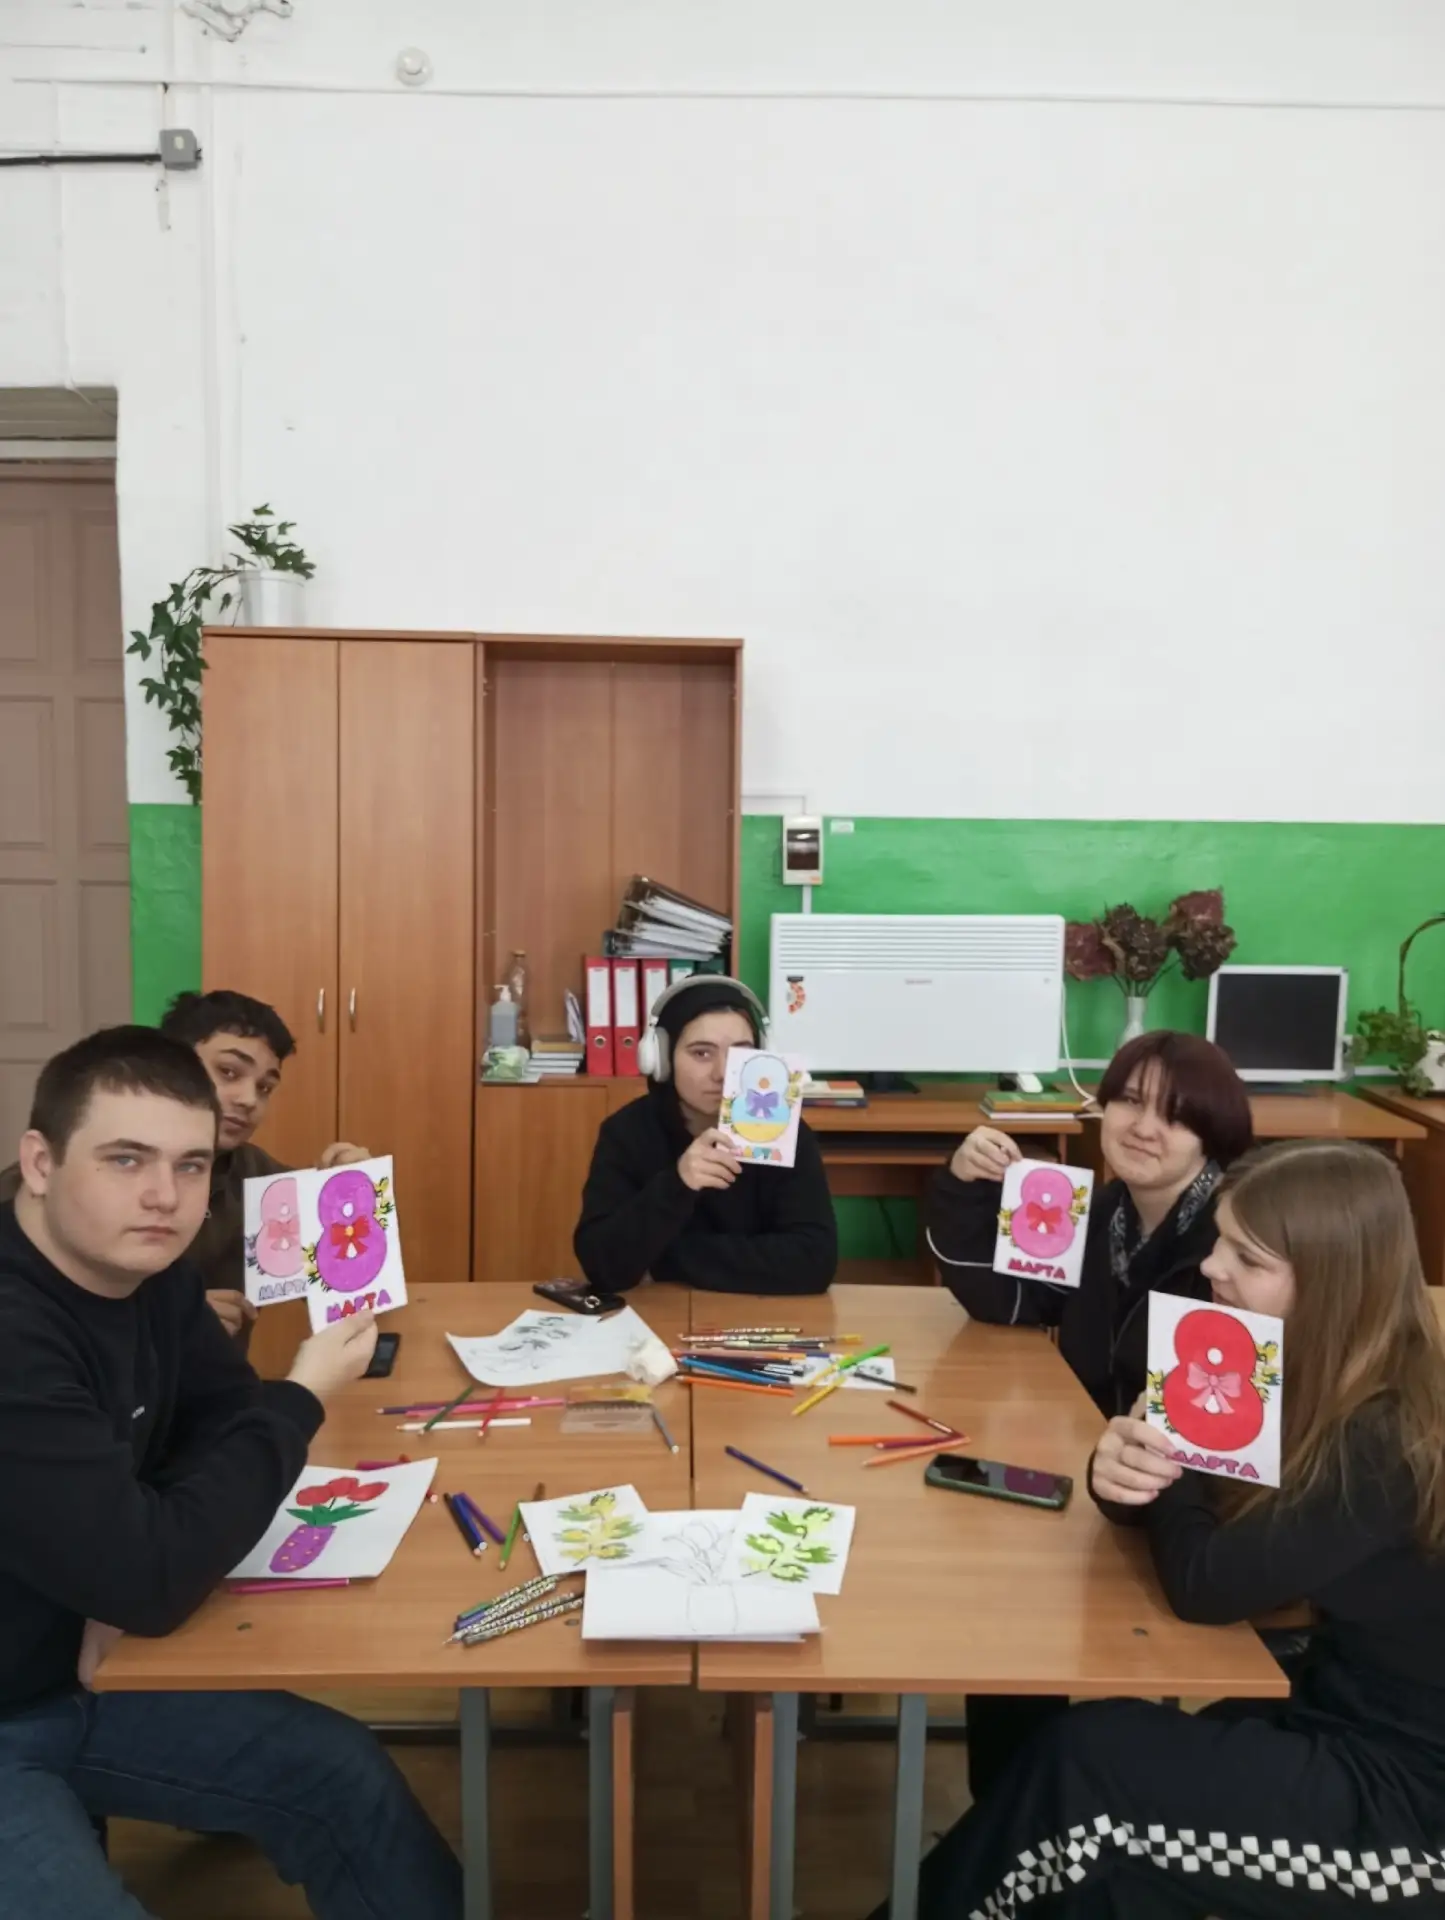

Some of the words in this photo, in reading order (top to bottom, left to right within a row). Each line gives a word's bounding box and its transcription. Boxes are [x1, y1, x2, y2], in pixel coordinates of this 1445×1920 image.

[731, 1054, 791, 1143] 8
[256, 1177, 304, 1277] 8
[316, 1170, 388, 1292] 8
[1011, 1167, 1076, 1259] 8
[1008, 1258, 1066, 1280] МАРТА
[1163, 1309, 1264, 1452] 8
